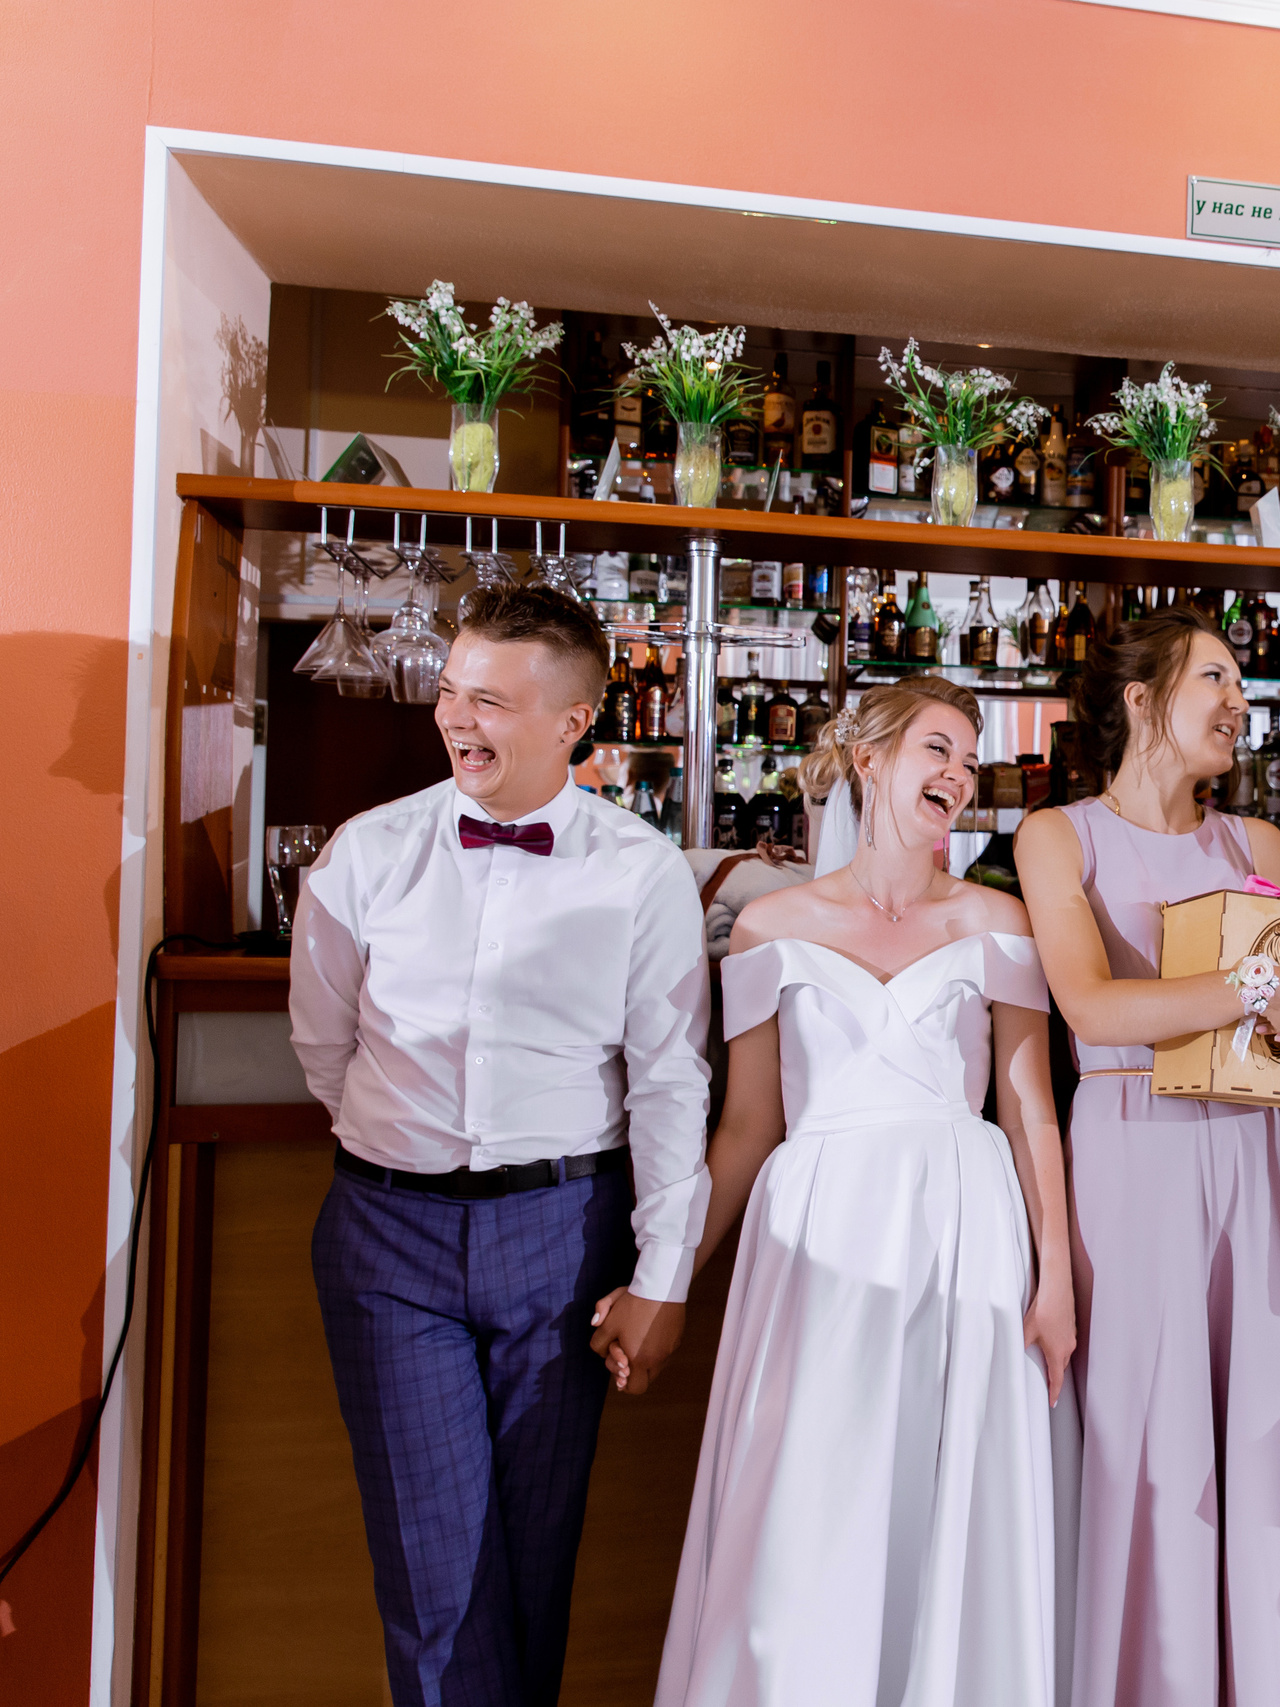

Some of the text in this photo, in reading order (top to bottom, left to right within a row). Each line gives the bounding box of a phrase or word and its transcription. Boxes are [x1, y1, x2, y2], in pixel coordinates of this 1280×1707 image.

[1196, 200, 1206, 215] у
[1212, 202, 1245, 216] нас
[1251, 205, 1273, 219] не
